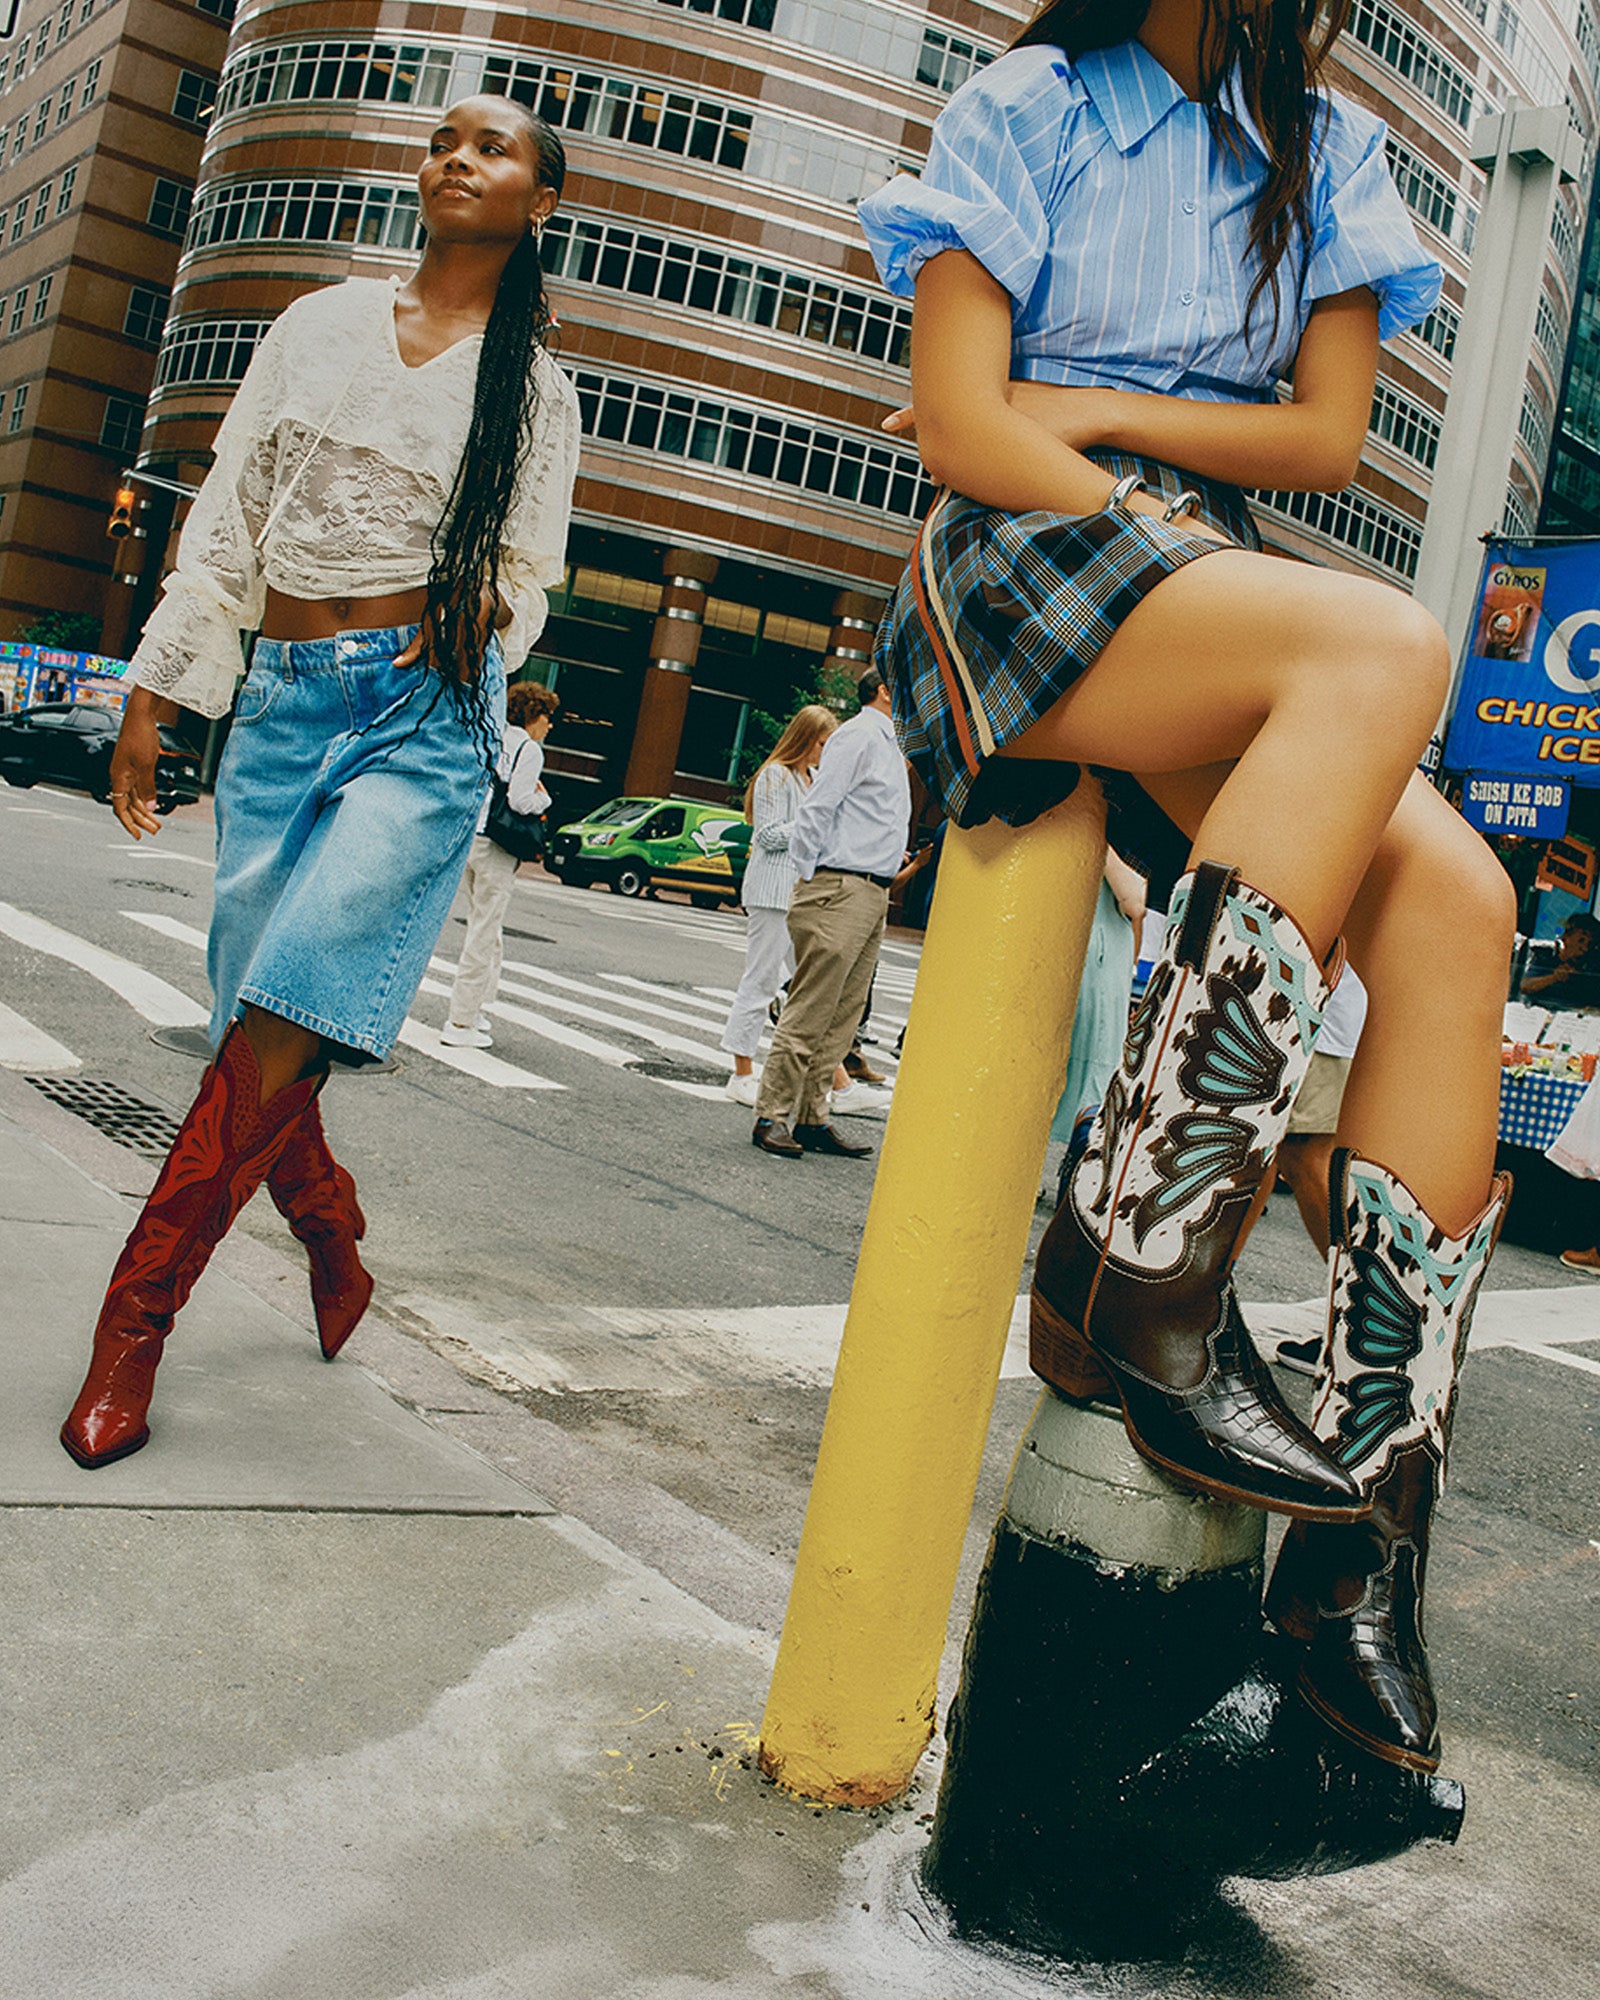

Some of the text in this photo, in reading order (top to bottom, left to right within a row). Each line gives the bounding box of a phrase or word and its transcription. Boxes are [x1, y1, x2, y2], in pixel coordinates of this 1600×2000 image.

[1493, 571, 1540, 590] GYROS
[1476, 697, 1600, 732] CHICK
[1538, 734, 1600, 764] ICE
[1469, 780, 1511, 804] SHISH
[1512, 783, 1532, 805] KE
[1534, 784, 1564, 807] BOB
[1484, 803, 1538, 828] ON PITA
